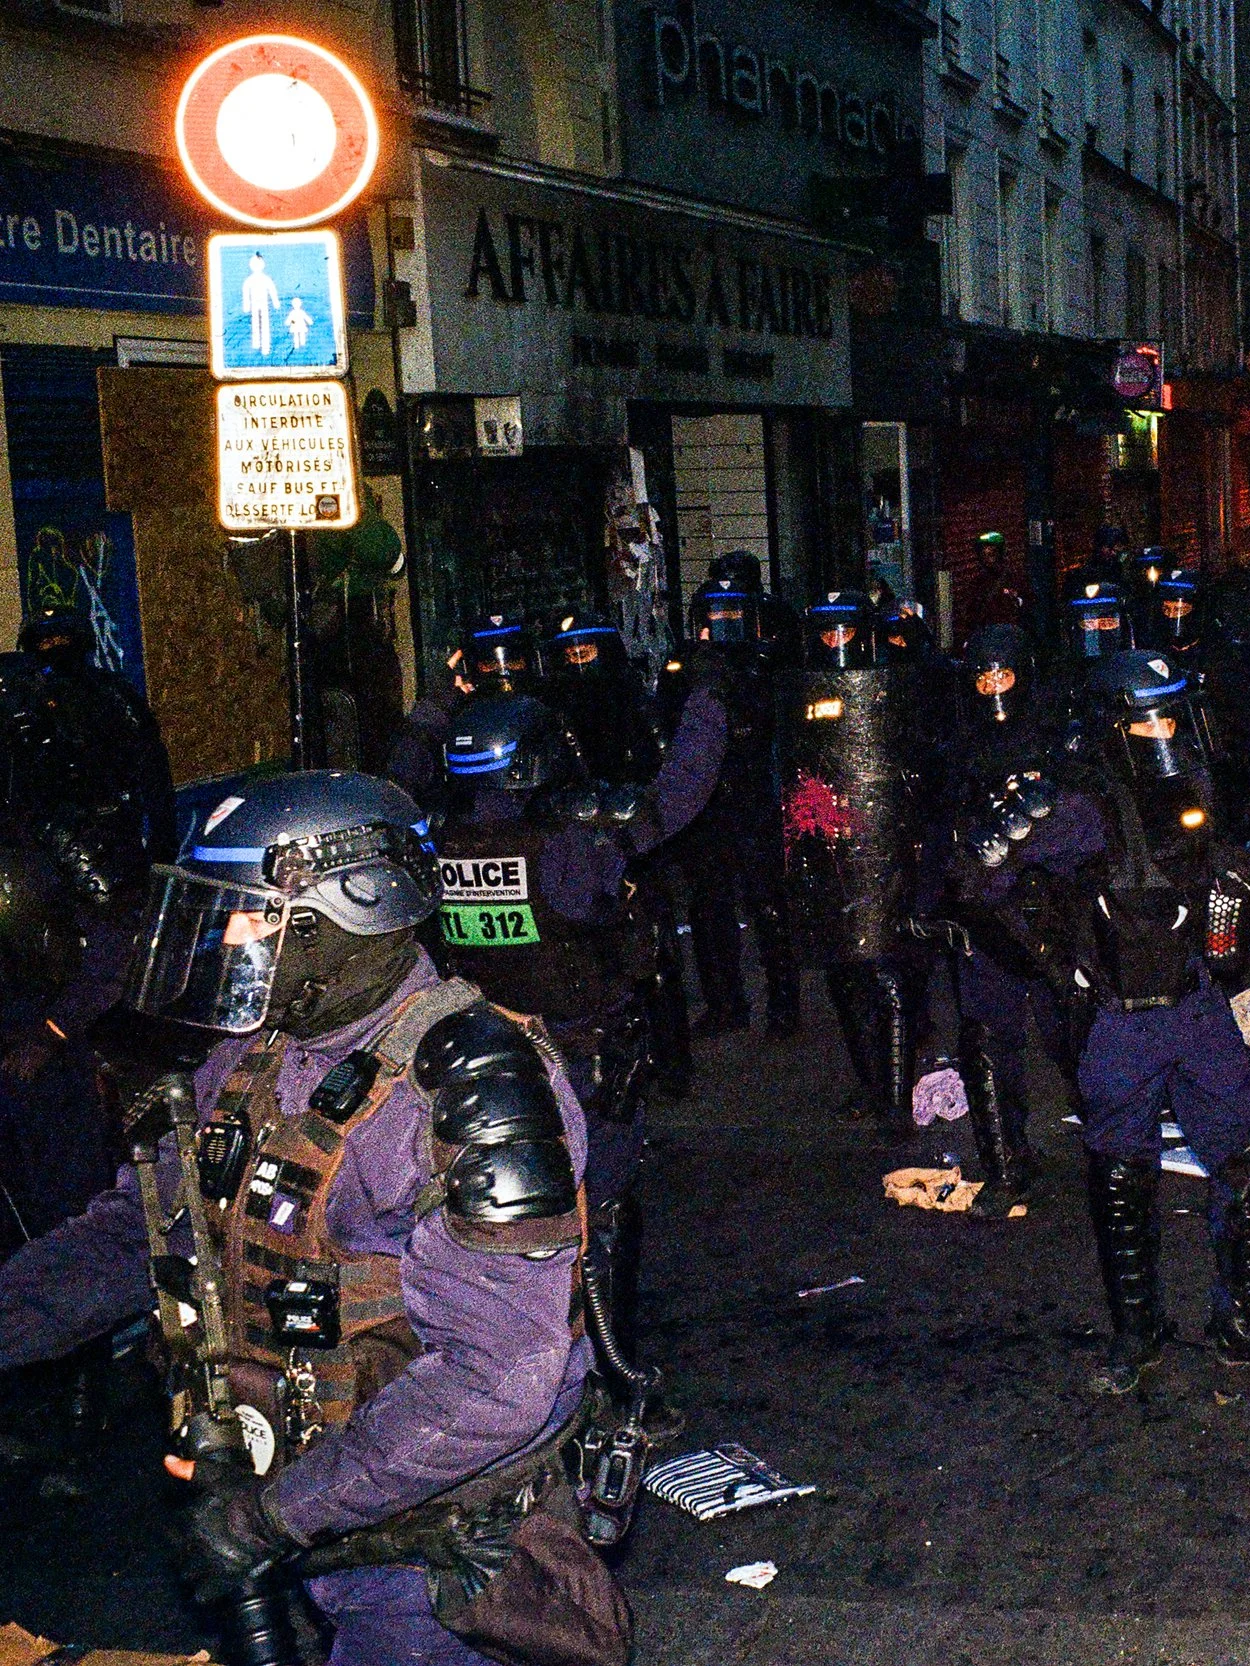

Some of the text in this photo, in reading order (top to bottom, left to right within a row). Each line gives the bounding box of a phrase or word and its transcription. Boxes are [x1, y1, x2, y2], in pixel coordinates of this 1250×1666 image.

[0, 208, 198, 267] re Dentaire
[464, 206, 696, 324] AFFAIRES
[233, 393, 332, 409] CIRCULATION
[244, 414, 325, 429] INTERDITE
[224, 439, 254, 451] AUX
[237, 481, 278, 495] SAUF
[284, 481, 314, 495] BUS
[441, 862, 521, 888] OLICE
[478, 911, 529, 940] 312
